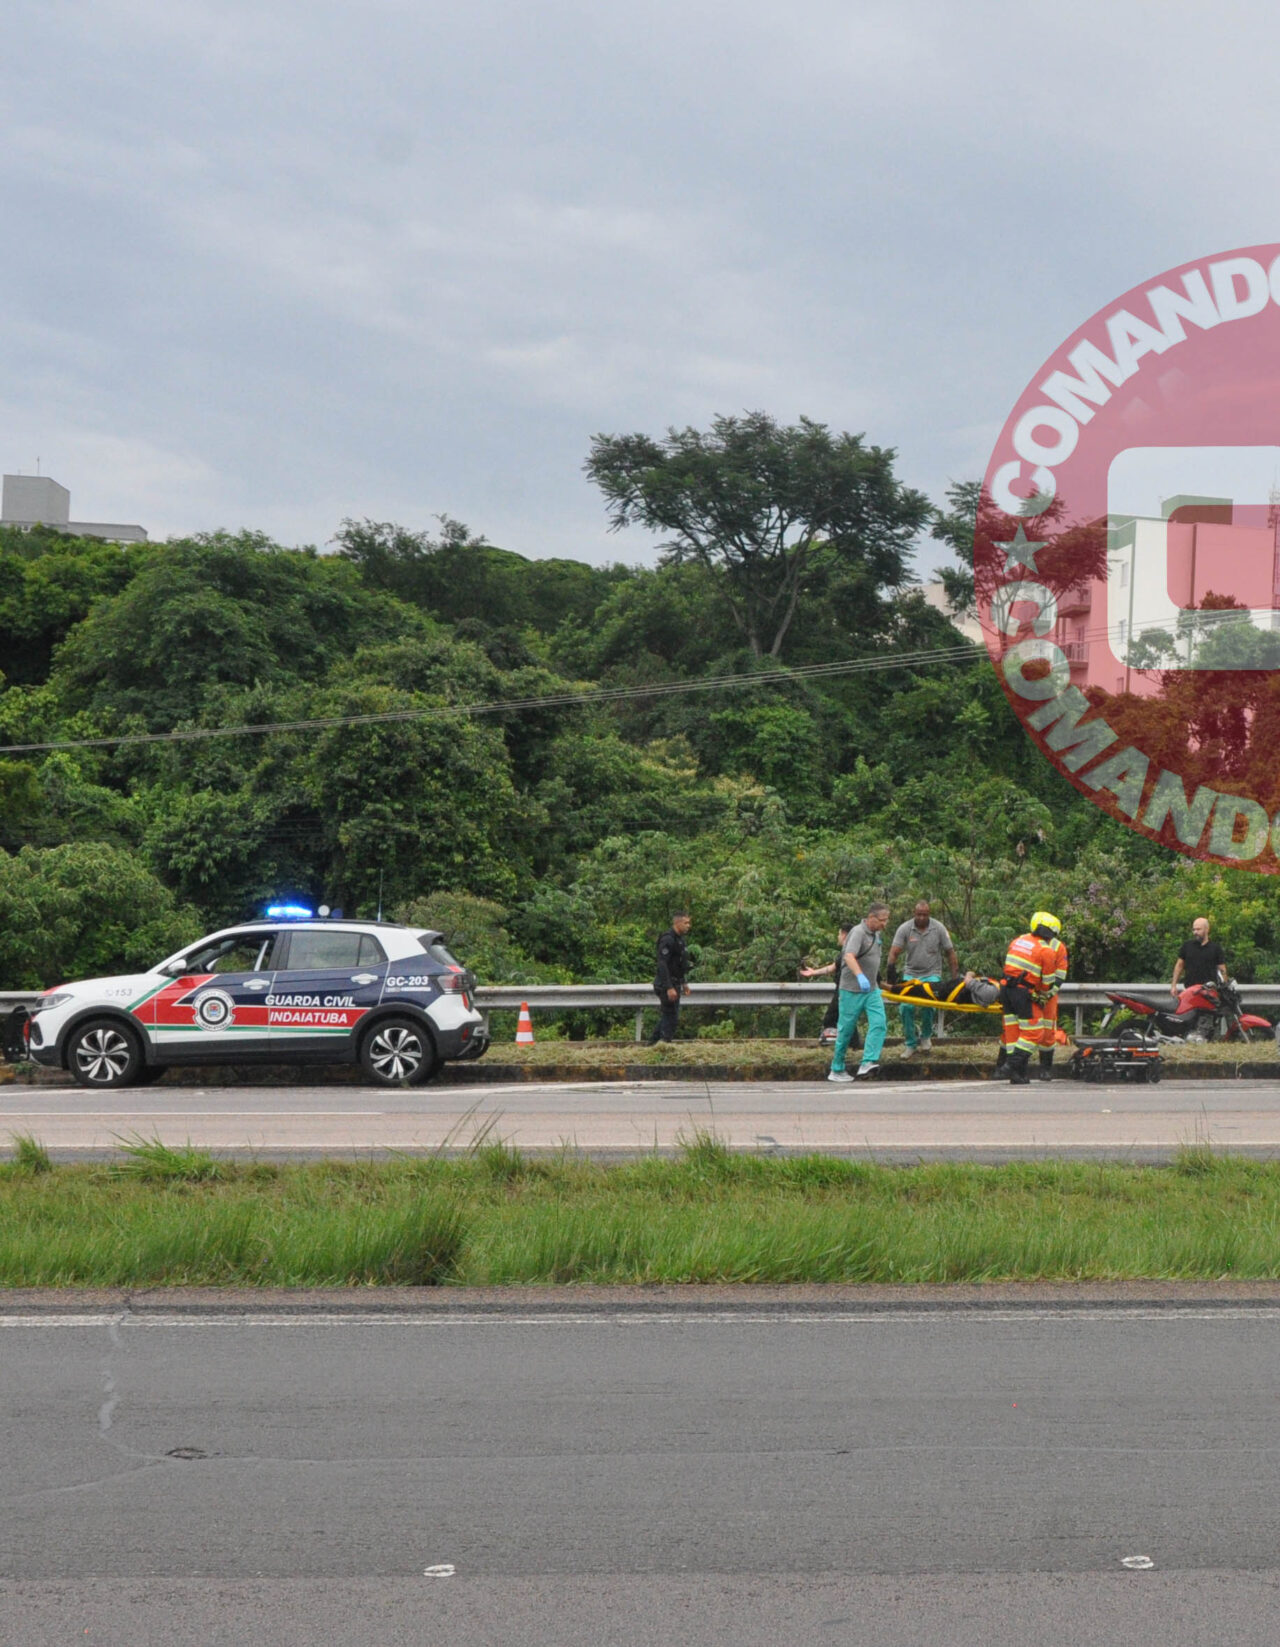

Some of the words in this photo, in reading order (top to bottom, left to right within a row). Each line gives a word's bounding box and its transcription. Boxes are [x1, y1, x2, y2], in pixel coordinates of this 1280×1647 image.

[386, 976, 429, 987] GC-203
[265, 995, 320, 1006] GUARDA
[324, 996, 356, 1007] CIVIL
[270, 1011, 348, 1024] INDAIATUBA
